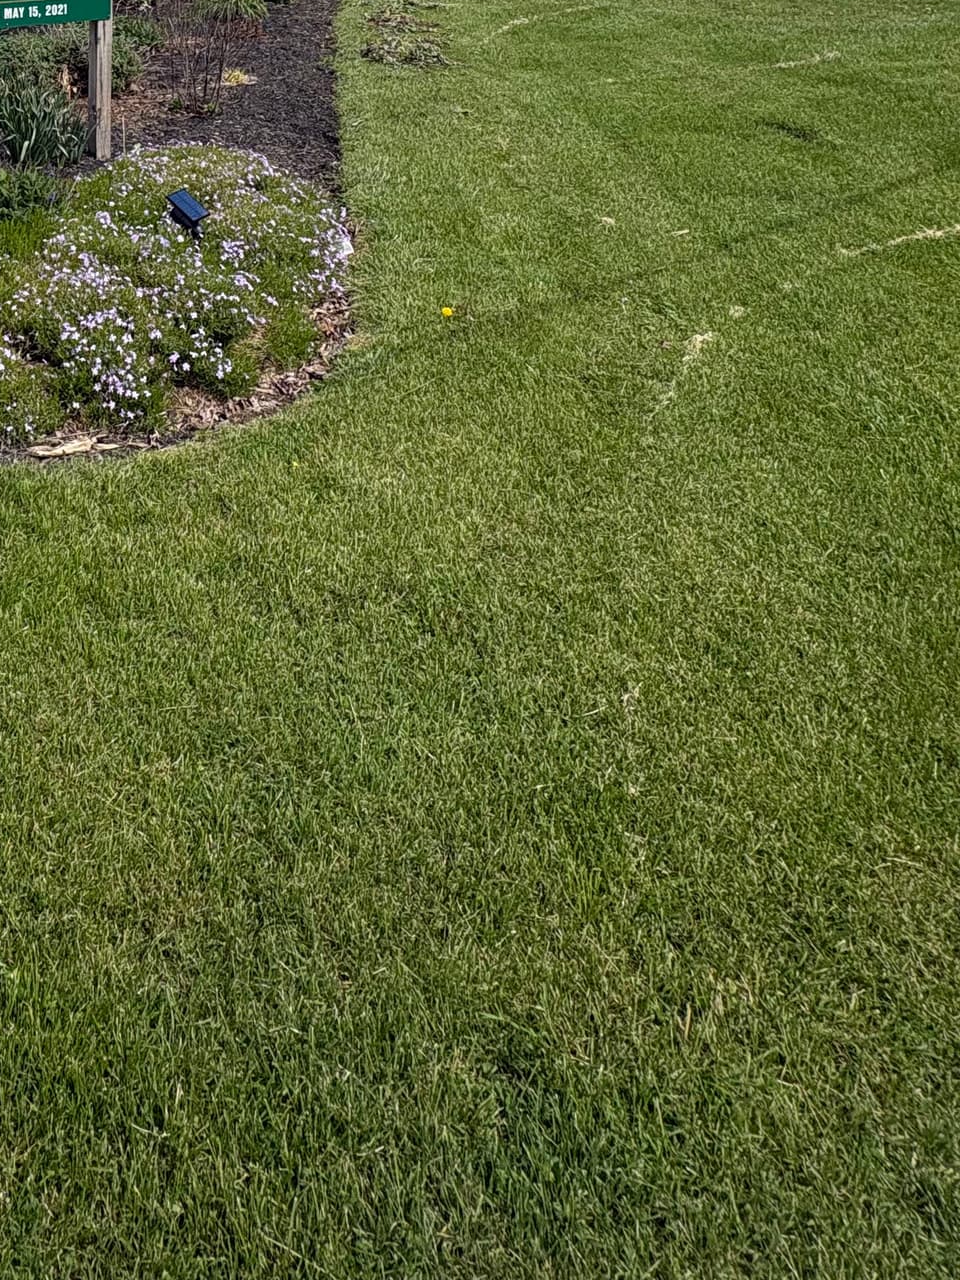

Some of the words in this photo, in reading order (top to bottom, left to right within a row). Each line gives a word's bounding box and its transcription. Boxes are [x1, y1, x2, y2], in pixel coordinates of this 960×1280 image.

[3, 5, 24, 19] MAY
[28, 5, 42, 19] 15,
[45, 3, 68, 17] 2021
